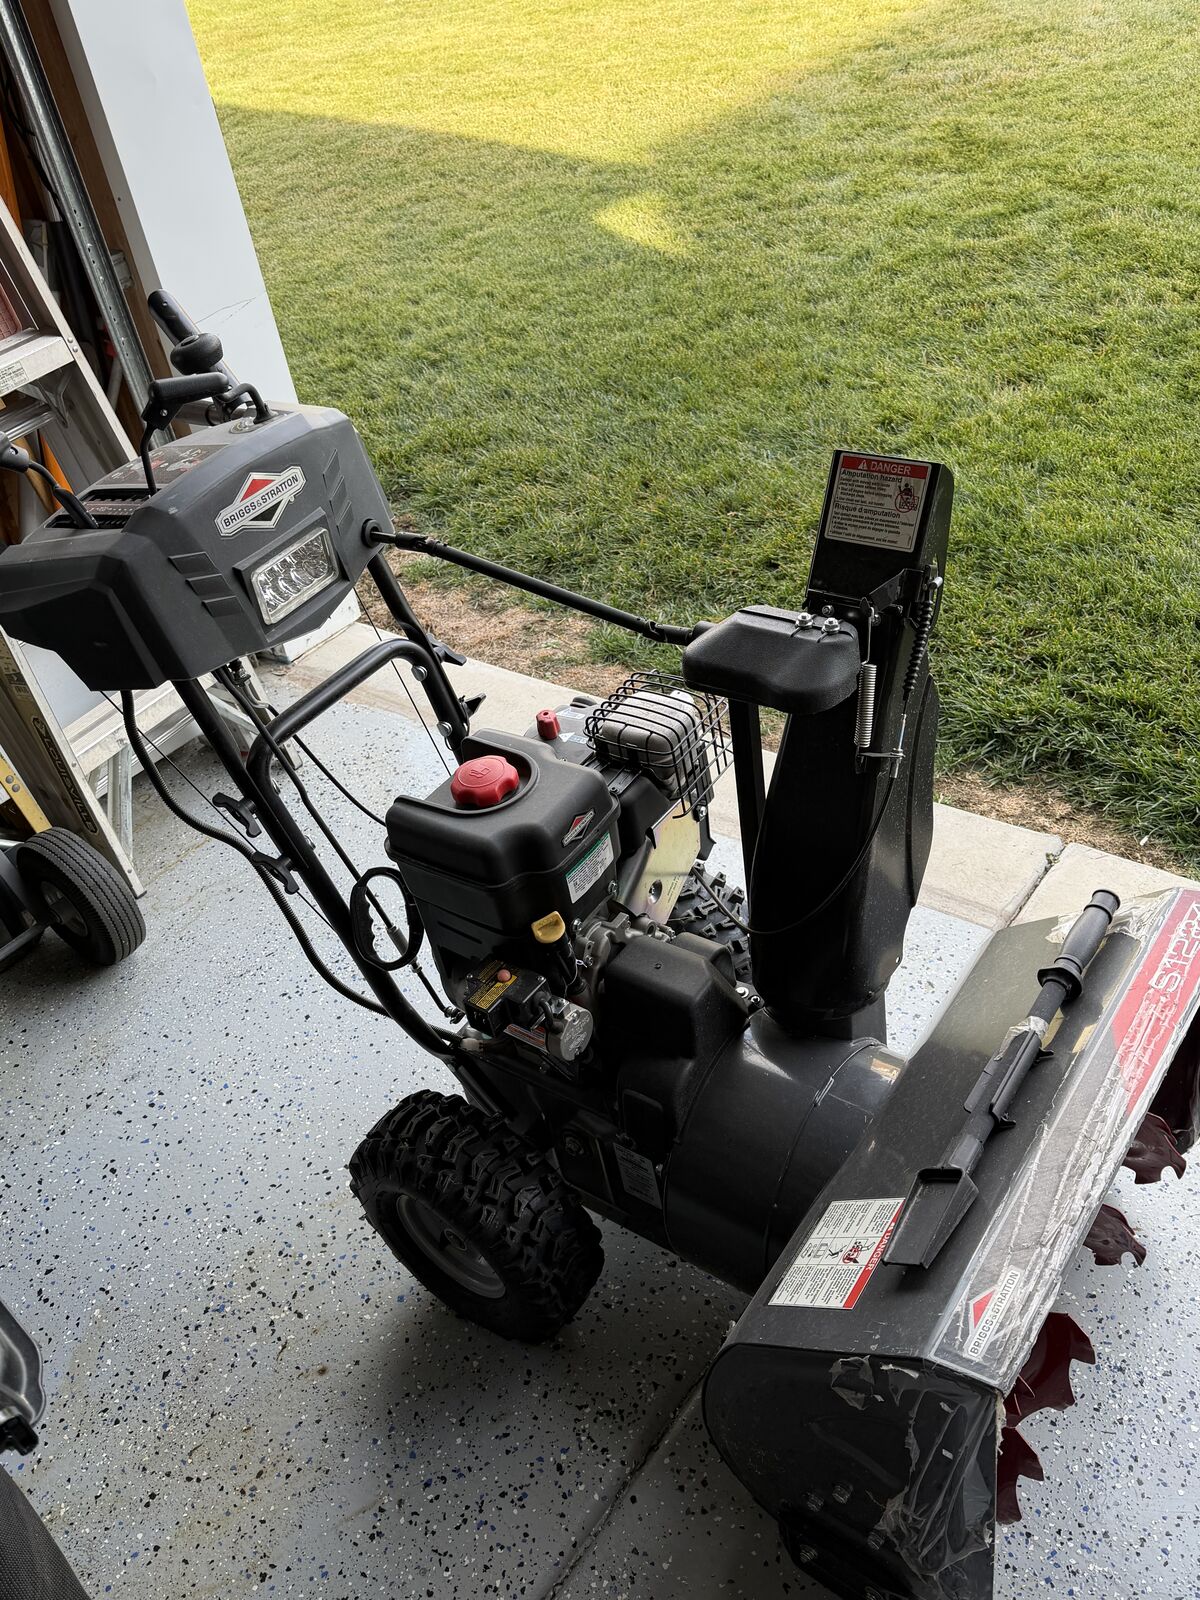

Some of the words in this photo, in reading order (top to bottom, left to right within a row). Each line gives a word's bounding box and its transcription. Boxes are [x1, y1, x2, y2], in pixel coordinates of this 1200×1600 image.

[870, 461, 911, 475] DANGER
[841, 469, 879, 480] Amputation
[880, 475, 903, 483] hazard
[834, 503, 857, 513] Risque
[43, 737, 97, 832] LOUISVILLE
[865, 1231, 891, 1271] DANGER
